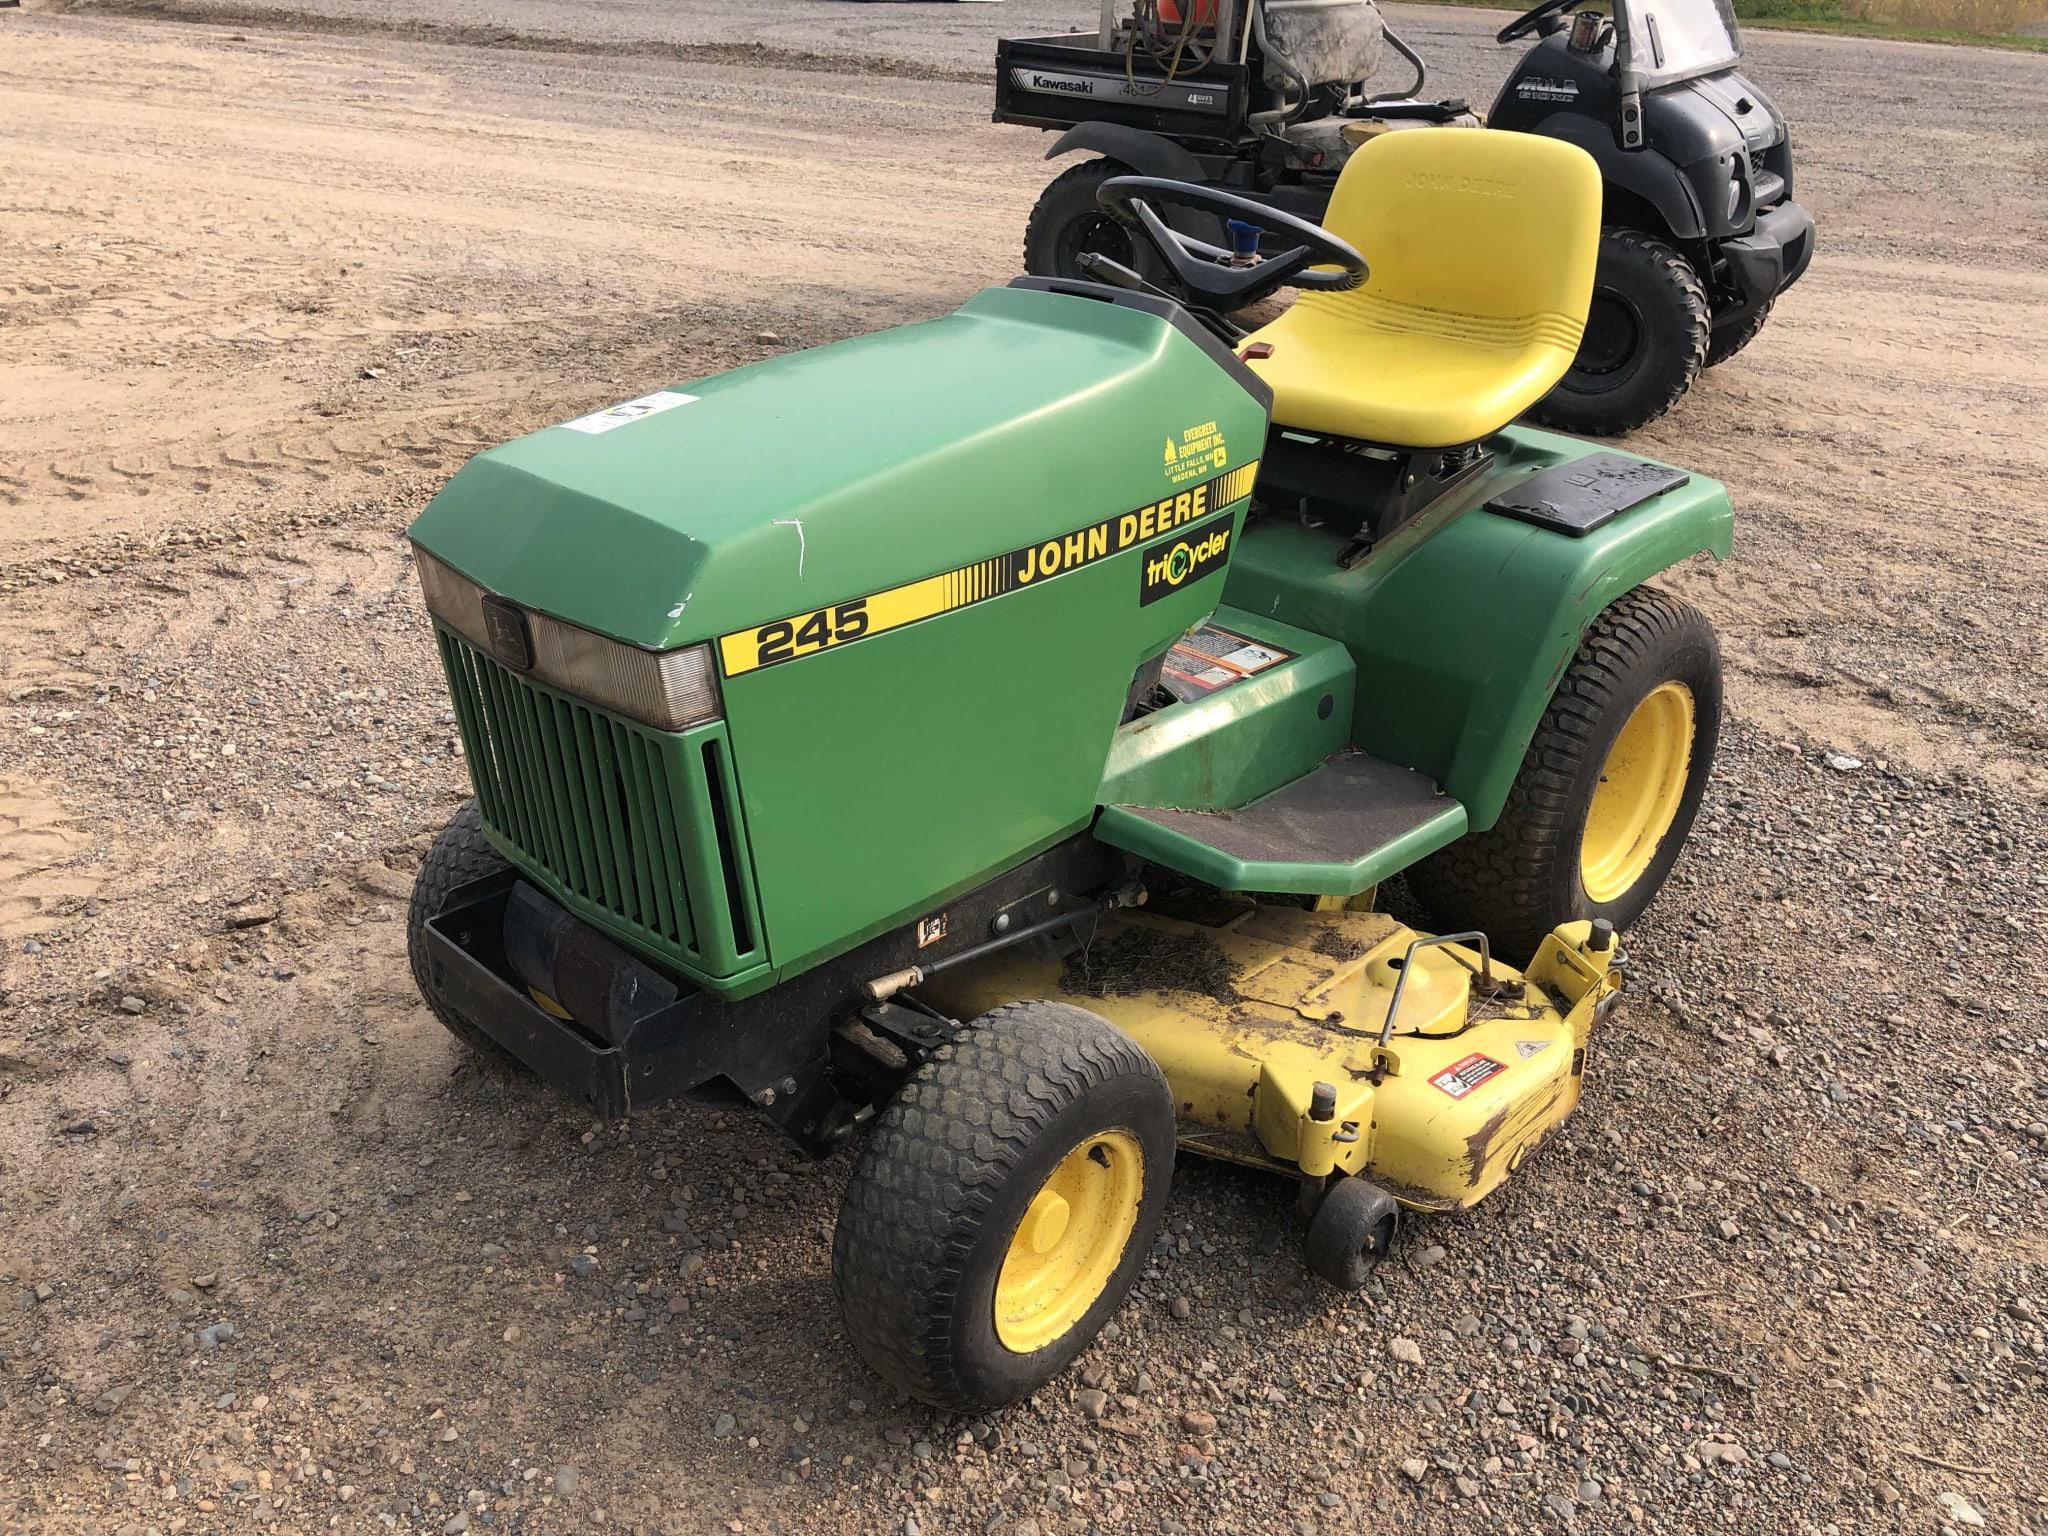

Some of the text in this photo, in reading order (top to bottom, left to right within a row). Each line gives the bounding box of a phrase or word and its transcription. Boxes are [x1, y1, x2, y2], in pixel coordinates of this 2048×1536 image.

[1033, 75, 1093, 94] Kawasaki
[1516, 76, 1580, 95] MULE
[1401, 172, 1519, 199] JOHN DEERE
[1183, 420, 1217, 443] EVERGREEN
[1178, 435, 1213, 459] EQUIPMENT
[1164, 462, 1186, 477] LITTLE
[1018, 484, 1208, 583] JOHN DEERE
[757, 598, 869, 666] 245
